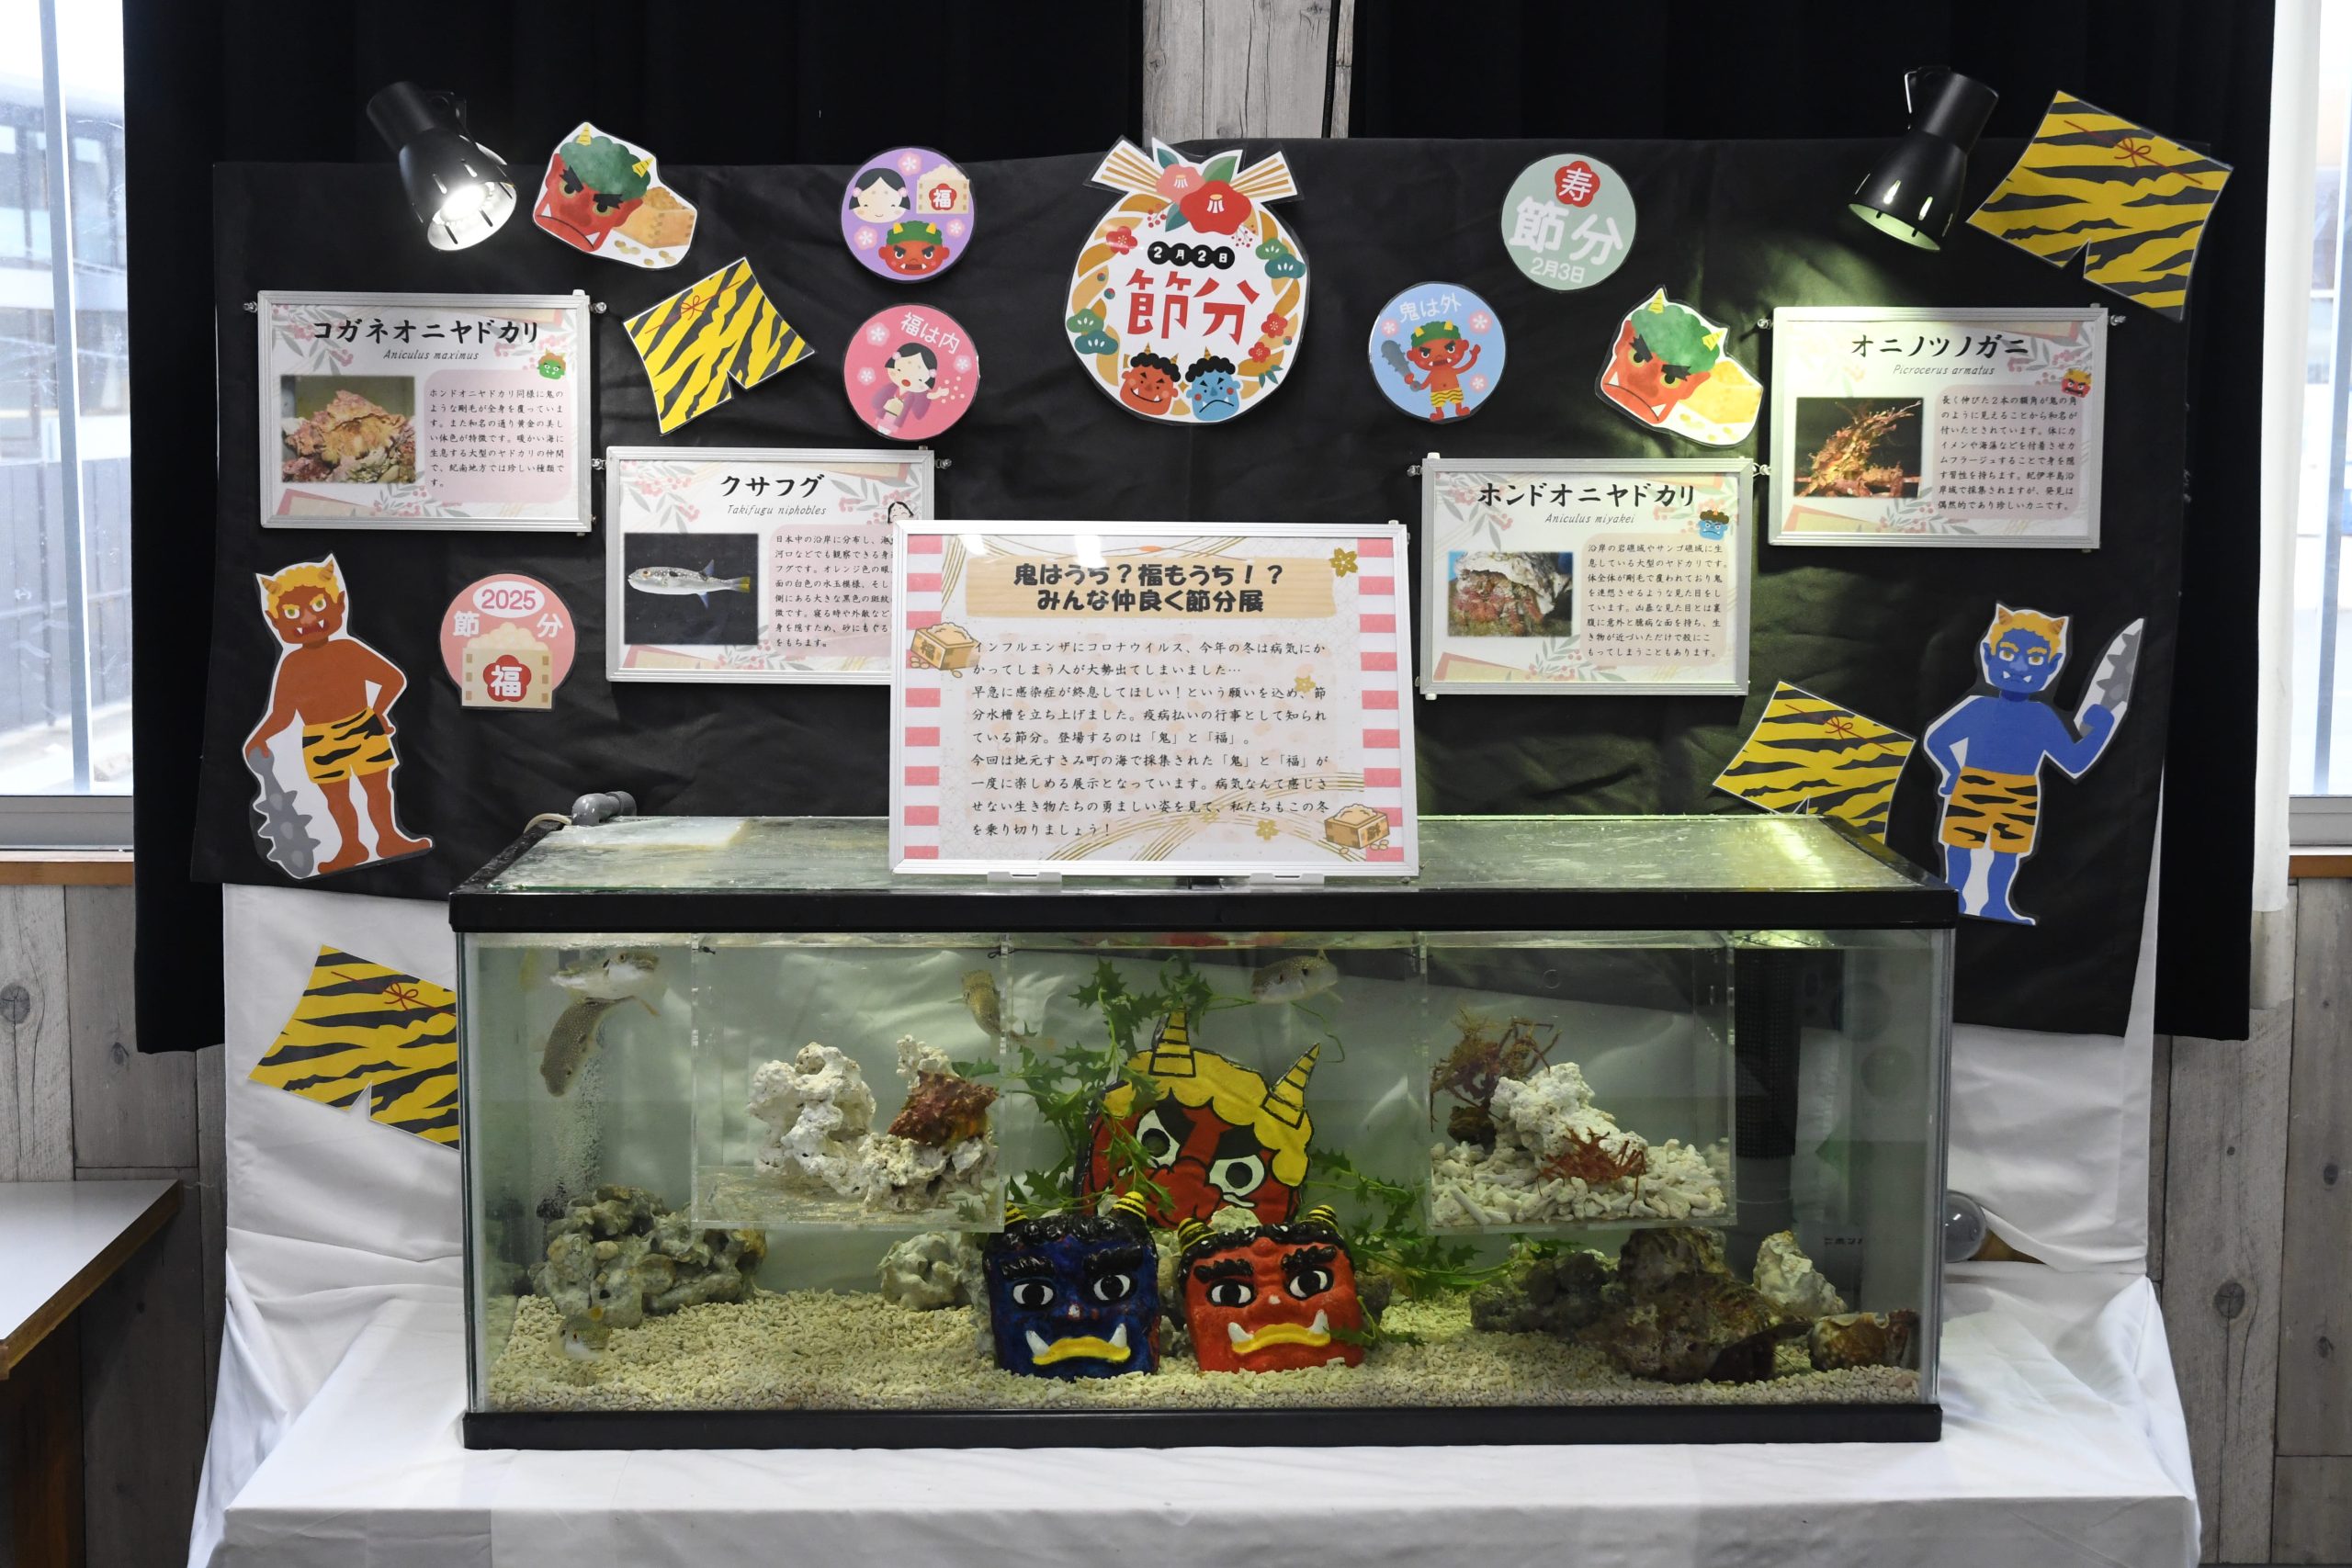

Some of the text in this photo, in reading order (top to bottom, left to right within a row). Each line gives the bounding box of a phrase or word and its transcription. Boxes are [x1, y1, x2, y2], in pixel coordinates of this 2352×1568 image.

[1558, 168, 1592, 201] 寿
[933, 188, 952, 209] 福
[1509, 197, 1623, 265] 節分
[1153, 246, 1228, 264] 2月2日
[1530, 256, 1586, 284] 2月3日
[1125, 267, 1261, 346] 節分
[1399, 292, 1462, 323] 鬼は外
[313, 319, 539, 344] コガネオニヤドカリ
[899, 310, 961, 355] 福は内
[1851, 333, 2030, 359] オニノツノガニ
[383, 348, 480, 360] Aniculus maximus
[1893, 365, 1996, 376] Picrocerus armatus
[430, 389, 564, 399] ホンドオニヤドカリ同様に鬼の
[430, 404, 564, 413] ような剛毛が全身を覆っていま
[1941, 411, 2077, 421] のように見えることから和名が
[430, 419, 564, 428] す。また和名の通り黄金の美し
[430, 434, 564, 444] い体色が特徴です。暖かい海に
[430, 448, 564, 458] 生息する大型のヤドカリの仲間
[430, 463, 565, 473] で、紀南地方では珍しい種類で
[430, 479, 446, 488] す。
[720, 473, 825, 498] クサフグ
[1477, 482, 1694, 507] ホンドオニヤドカリ
[727, 504, 827, 516] Takifugu niphobles
[1545, 513, 1635, 525] Aniculus miyakei
[775, 549, 893, 559] 河口などでも観察できる身
[1588, 558, 1727, 569] 息している大型のヤドカリです。
[776, 579, 891, 589] 面の白色の水玉模様、そし
[1588, 573, 1723, 583] 体全体が剛毛で覆われており鬼
[481, 589, 536, 610] 2025
[775, 593, 892, 604] 側にある大きな黒色の斑紋
[1589, 589, 1721, 598] を連想させるような見た目をし
[1037, 589, 1264, 613] みんな仲良く節分展
[775, 609, 891, 618] 徴です。寝る時や外敵など
[775, 624, 890, 633] 身を隠すため、砂にもぐる
[776, 638, 827, 648] をもちます。
[1588, 633, 1711, 642] き物が近づいただけで殻にこ
[976, 641, 1326, 655] インフルエンザにコロナウイルス、今年の冬は病気にか
[1589, 648, 1716, 658] もってしまうこともあります。
[491, 664, 523, 697] 福
[972, 708, 1327, 722] 分水槽を立ち上げました。疫病払いの行事として知られ
[973, 731, 1250, 745] ている節分。登場するのは「鬼」と「福」。
[971, 753, 1329, 768] 今回は地元すさみ町の海で採集された「鬼」と「福」が
[971, 777, 1328, 791] 一度に楽しめる展示となっています。病気なんて感じさ
[972, 800, 1329, 814] せない生き物たちの勇ましい姿を見て、私たちもこの冬
[973, 823, 1110, 837] を乗り切りましょう！
